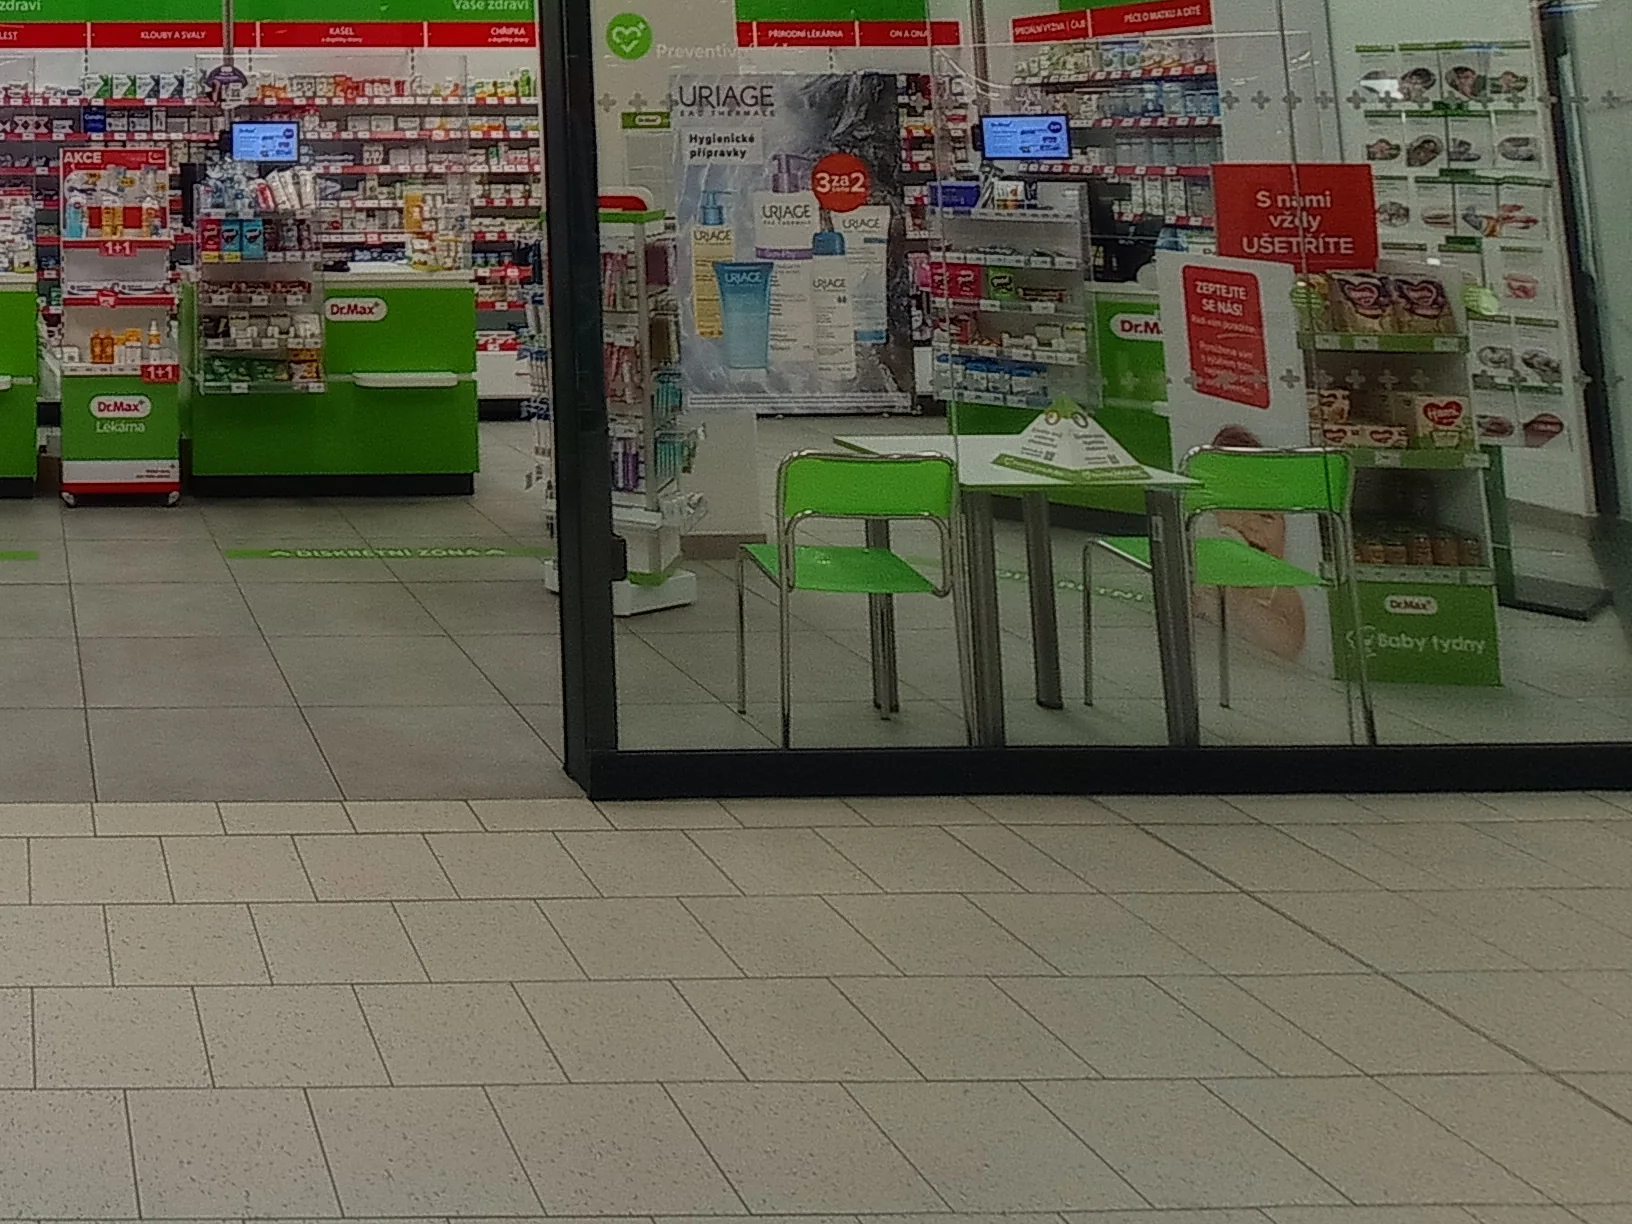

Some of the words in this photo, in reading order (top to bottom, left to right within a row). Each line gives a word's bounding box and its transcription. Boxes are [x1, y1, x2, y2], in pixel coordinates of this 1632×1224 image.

[140, 30, 172, 40] KLOUBY
[181, 30, 206, 40] SVALY
[328, 25, 355, 36] KAŠEL
[679, 85, 775, 109] URIAGE
[689, 132, 755, 146] Hygienické
[63, 151, 103, 164] AKCE
[689, 147, 747, 159] přípravky
[816, 172, 830, 193] 3
[831, 175, 849, 187] za
[851, 172, 865, 193] 2
[1255, 190, 1272, 208] S
[1276, 190, 1332, 208] nami
[761, 204, 812, 221] URIAGE
[842, 217, 881, 231] URIAGE
[1268, 211, 1322, 232] vždy
[693, 229, 732, 243] URIAGE
[1241, 232, 1355, 254] UŠETŘÍTE
[104, 241, 131, 255] 1+1
[723, 271, 764, 285] URIAGE
[812, 278, 847, 290] URIAGE
[1195, 280, 1247, 300] ZEPTEJTE
[1201, 298, 1217, 312] SE
[1217, 299, 1244, 316] NÁS!
[146, 365, 174, 380] 1+1
[95, 419, 146, 433] Lékárna
